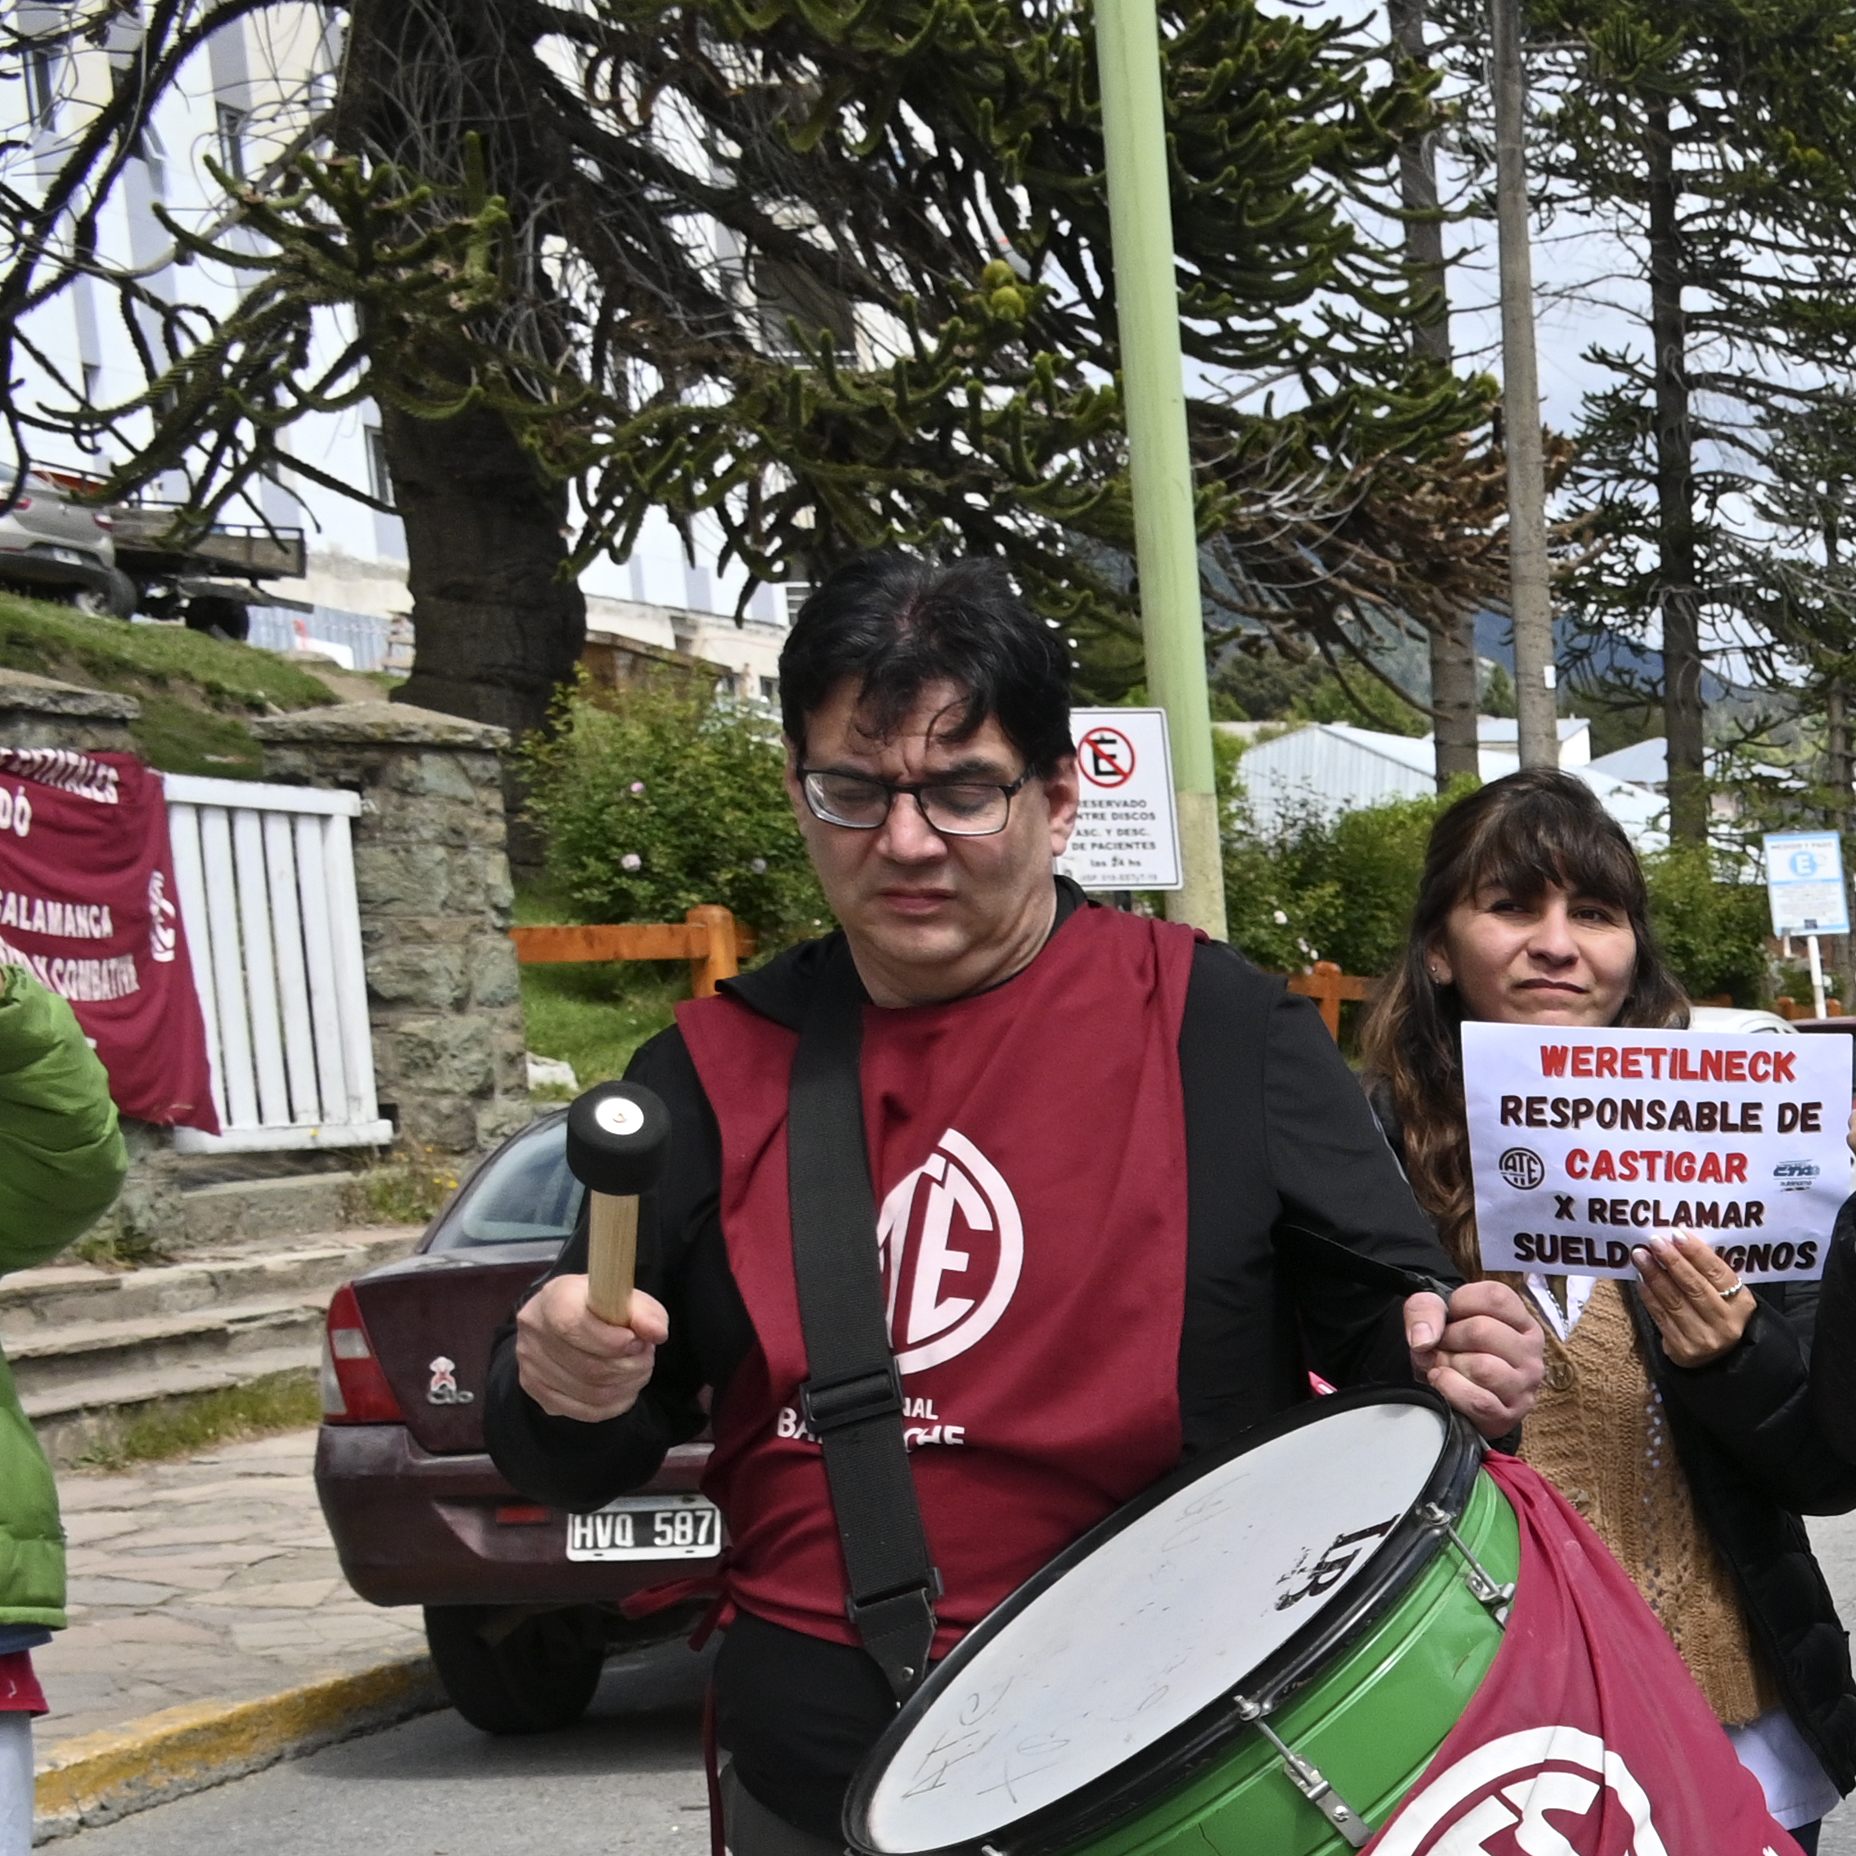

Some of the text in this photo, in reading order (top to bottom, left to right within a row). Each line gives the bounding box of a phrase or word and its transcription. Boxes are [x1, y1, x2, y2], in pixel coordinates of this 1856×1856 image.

[1076, 812, 1156, 821] NTRE DISCOS
[1072, 842, 1156, 851] DE PACIENTES
[0, 889, 114, 939] ALAMANCA
[1540, 1045, 1796, 1083] WERETILNECK
[1500, 1095, 1822, 1133] RESPONSABLE DE
[1565, 1148, 1748, 1183] CASTIGAR
[1554, 1195, 1764, 1229] X RECLAMAR
[1514, 1233, 1650, 1270] SUELD
[574, 1510, 714, 1549] HVQ 587
